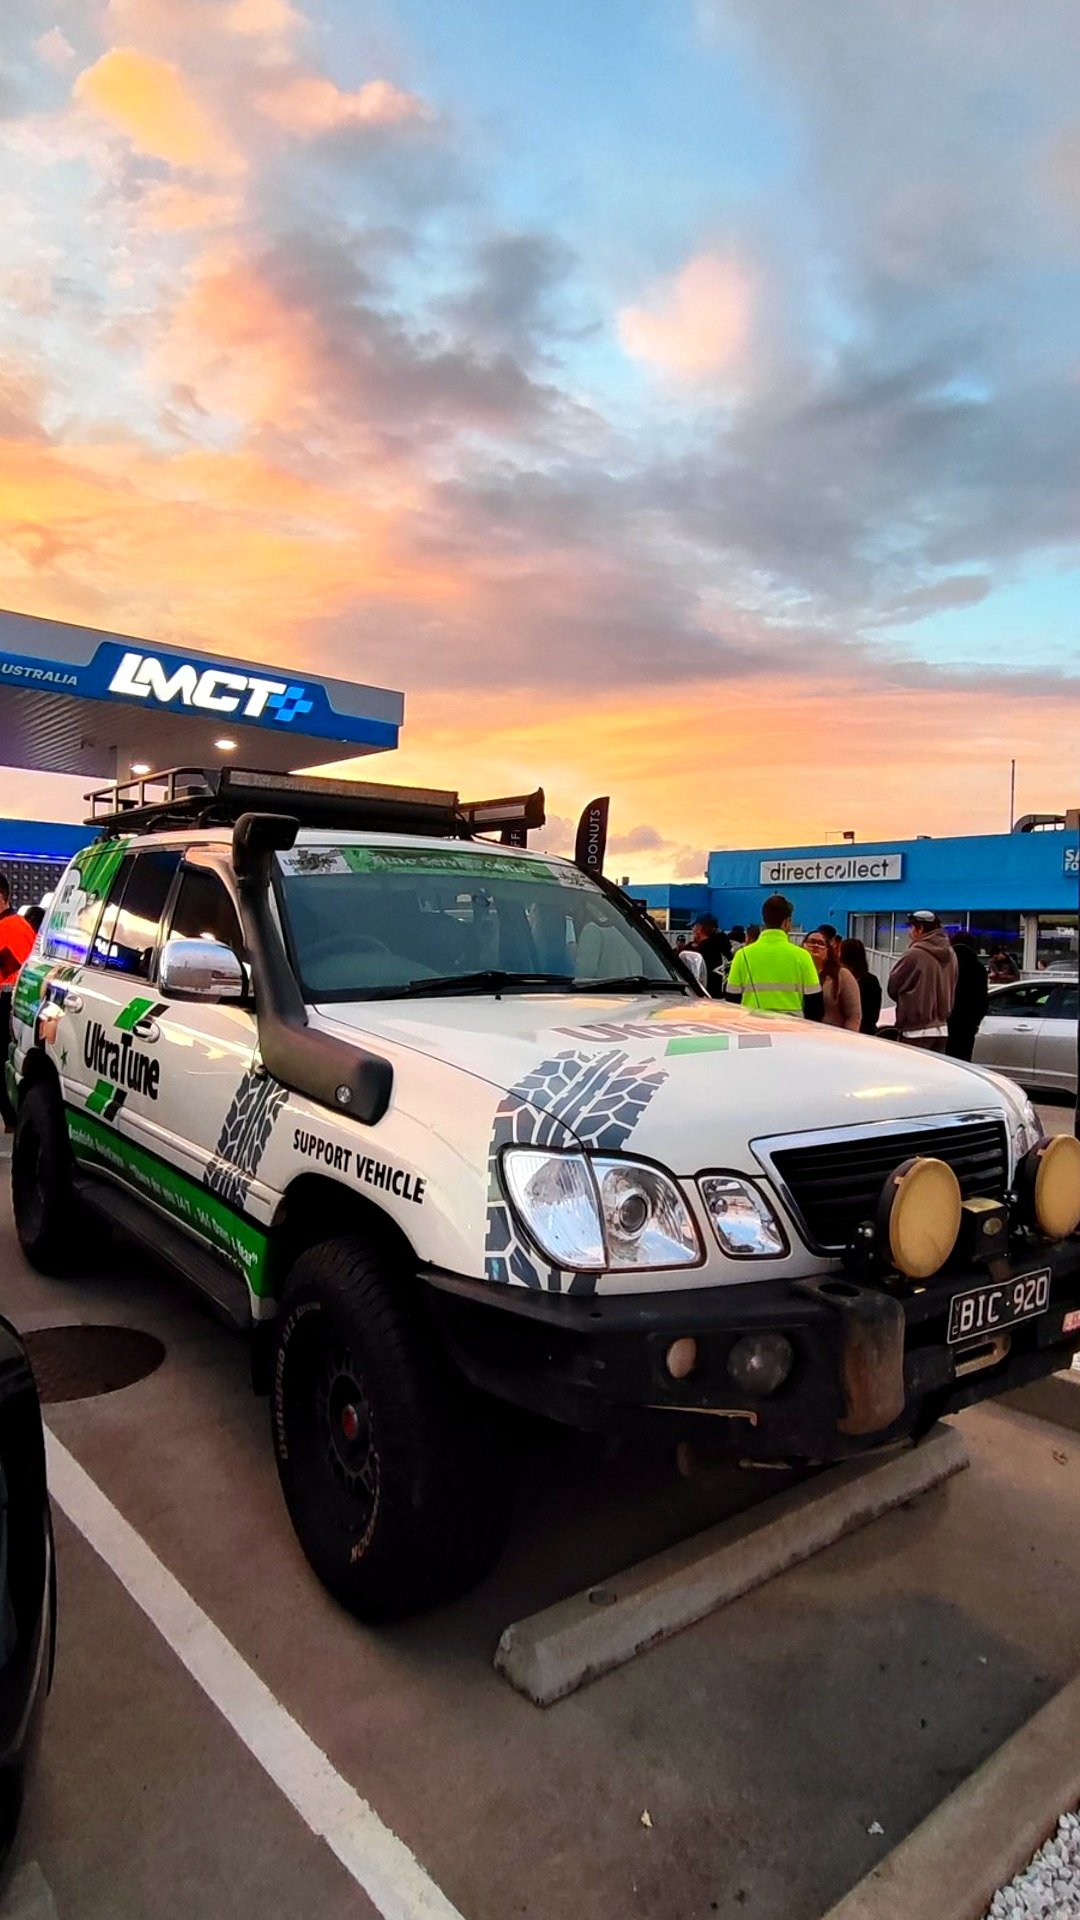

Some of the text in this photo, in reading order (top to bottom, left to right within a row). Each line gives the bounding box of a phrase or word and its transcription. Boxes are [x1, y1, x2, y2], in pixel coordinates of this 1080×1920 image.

[587, 809, 601, 864] DONUTS
[293, 1128, 427, 1204] SUPPORT VEHICLE
